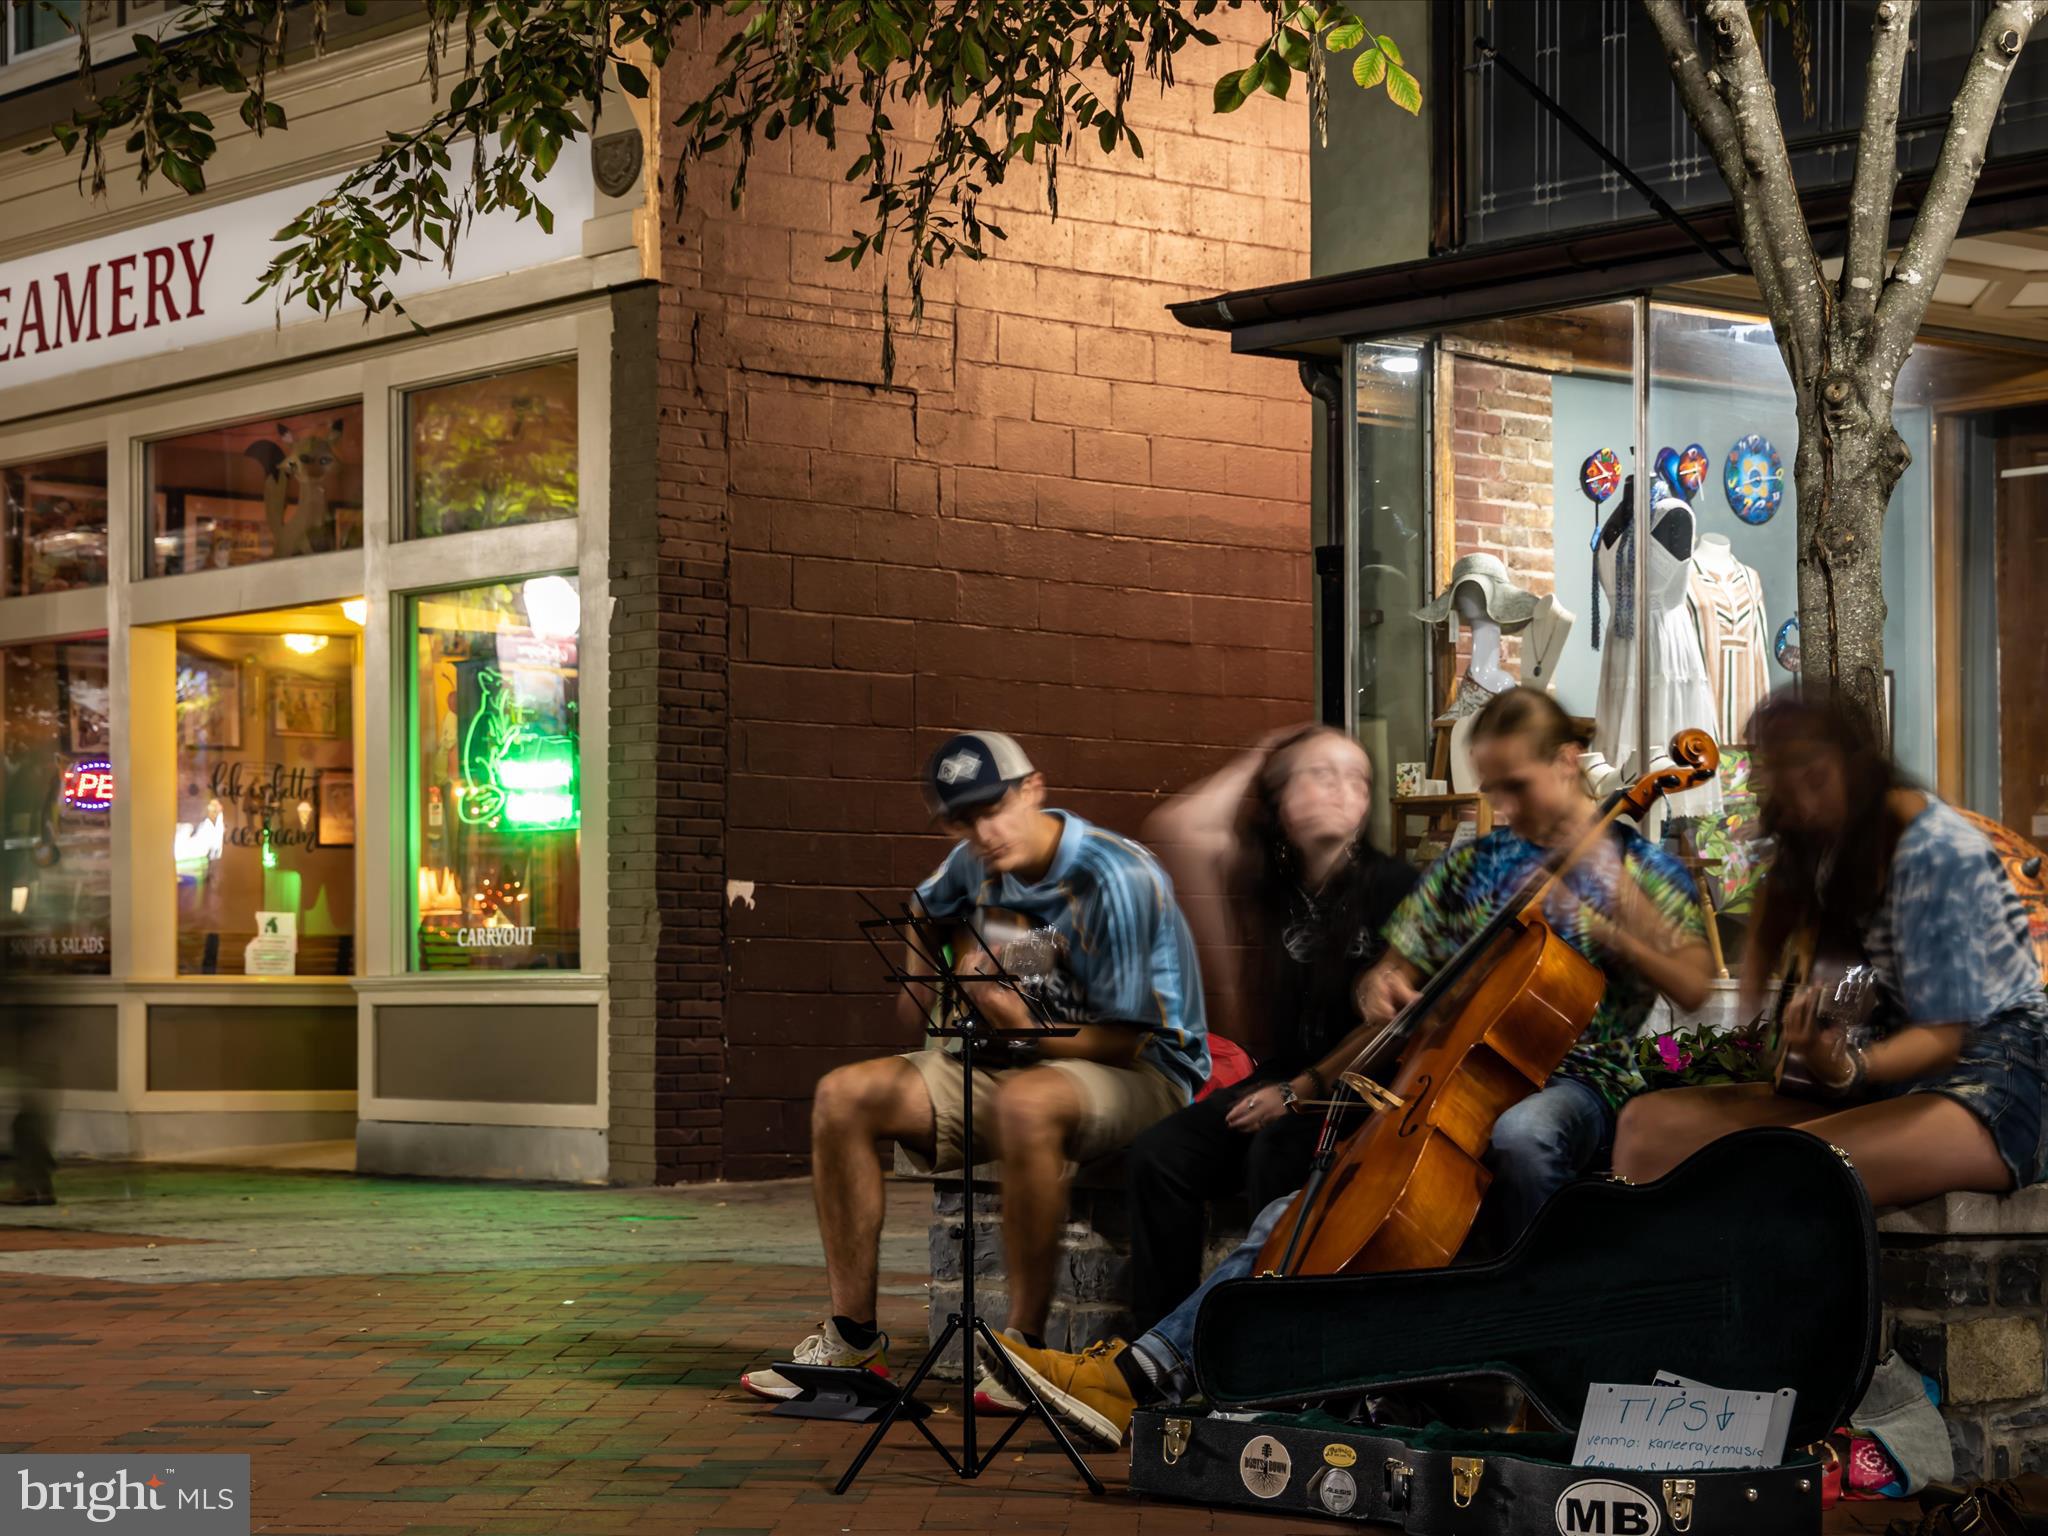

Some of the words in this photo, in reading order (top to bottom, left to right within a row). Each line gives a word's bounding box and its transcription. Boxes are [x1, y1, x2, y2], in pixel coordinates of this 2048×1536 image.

[61, 935, 105, 955] SALADS
[457, 926, 536, 948] CARRYOUT
[1619, 1396, 1708, 1432] TIPS
[1566, 1498, 1650, 1536] MB
